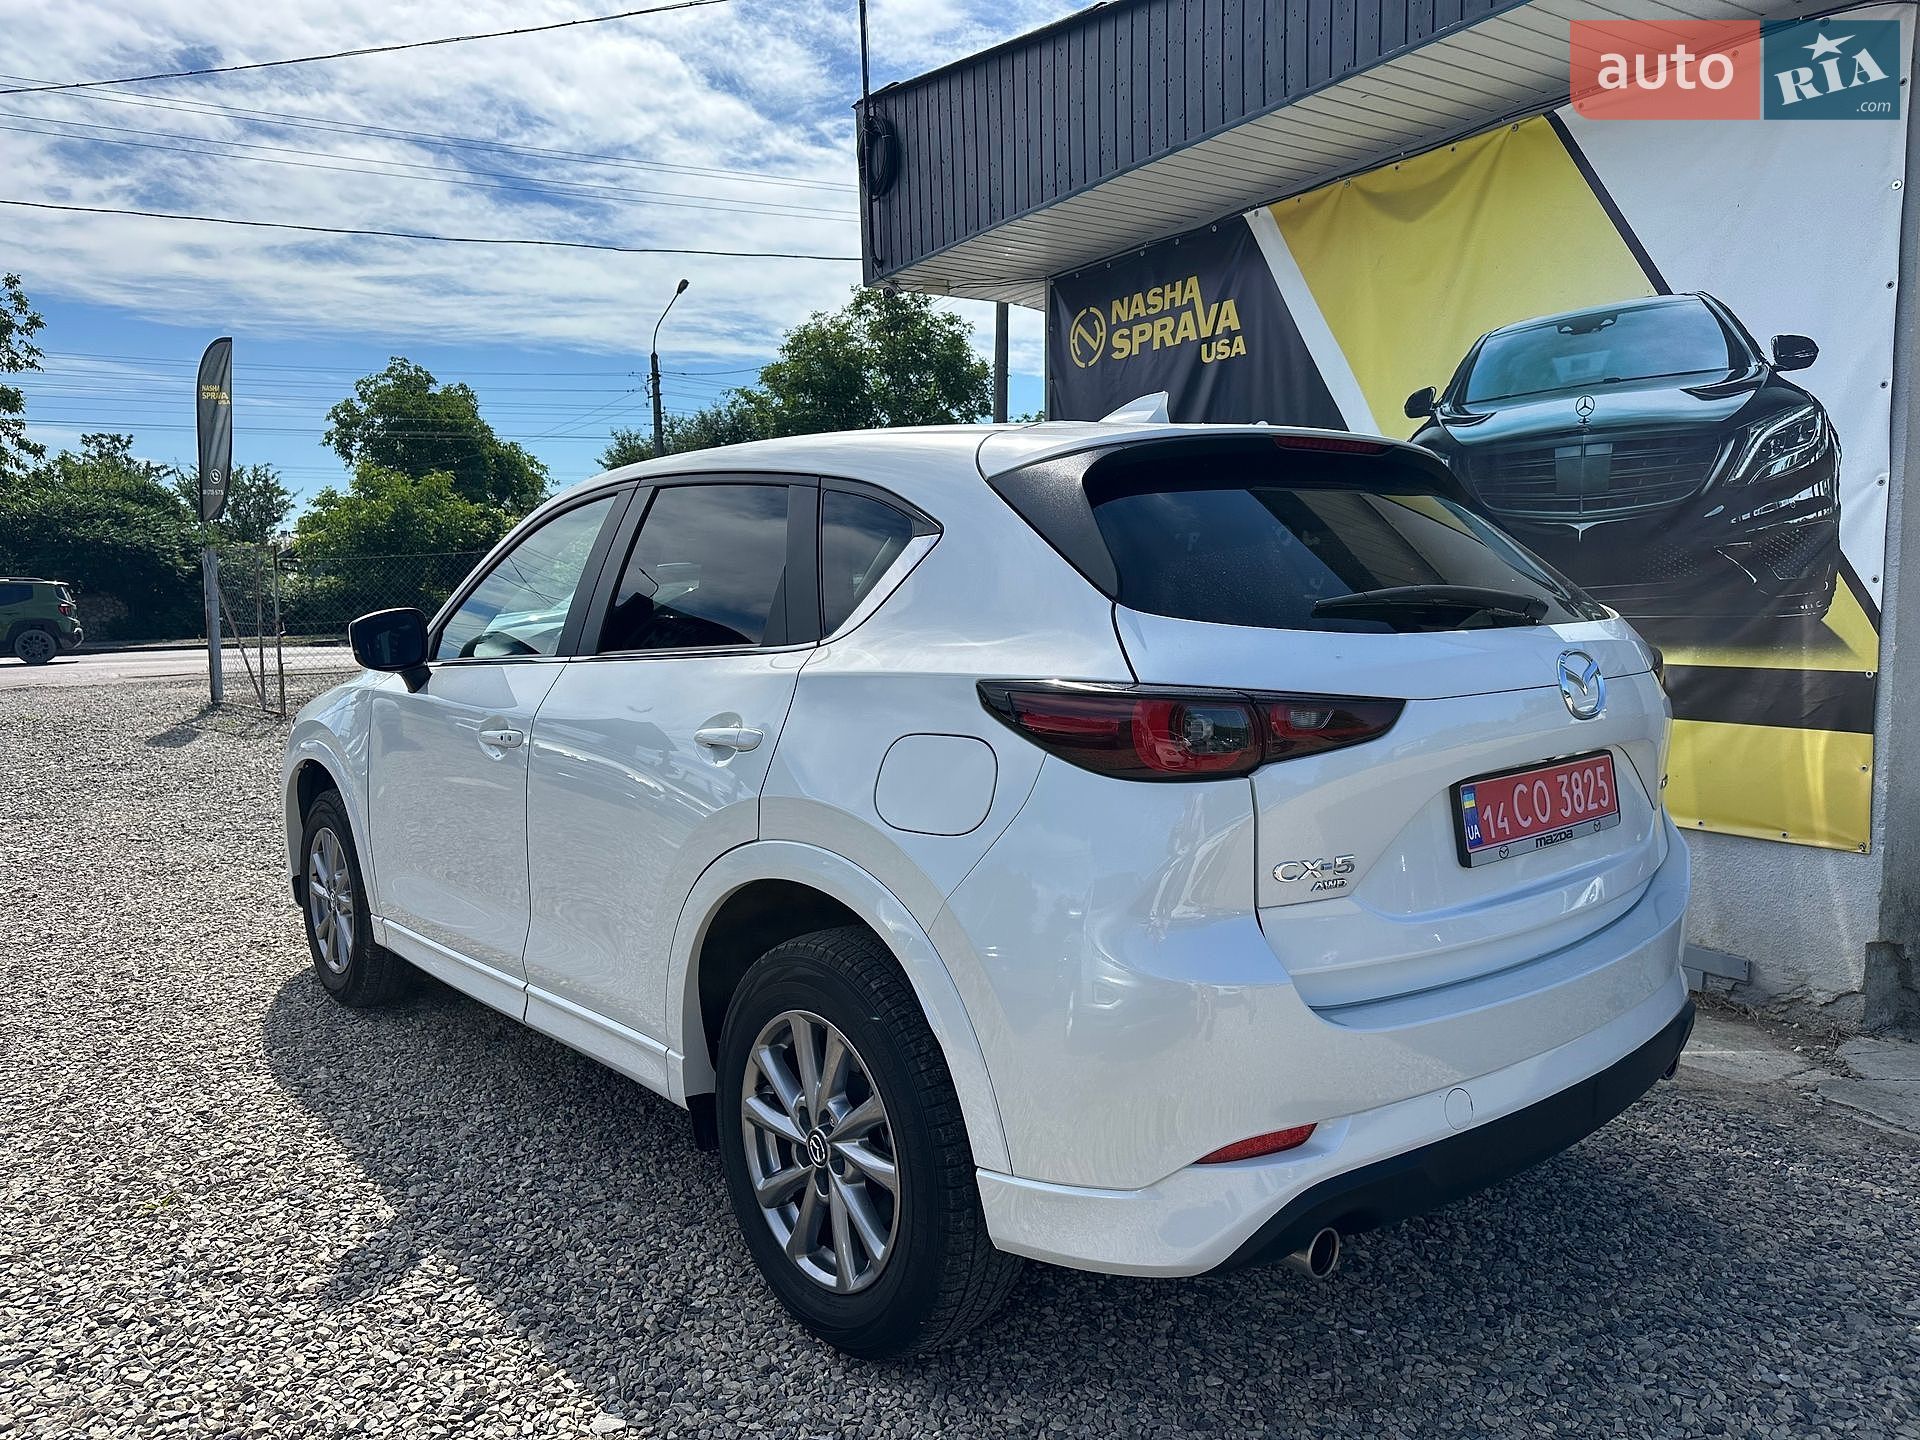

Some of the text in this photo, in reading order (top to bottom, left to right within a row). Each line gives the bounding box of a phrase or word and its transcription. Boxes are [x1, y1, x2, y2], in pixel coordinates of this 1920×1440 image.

[1111, 275, 1202, 325] NASHA
[1111, 298, 1241, 361] SPRAVA
[1201, 335, 1247, 364] USA
[1556, 765, 1609, 818] 3825
[1467, 825, 1481, 840] UA
[1272, 853, 1355, 882] CX-5
[1310, 878, 1348, 892] AWD
